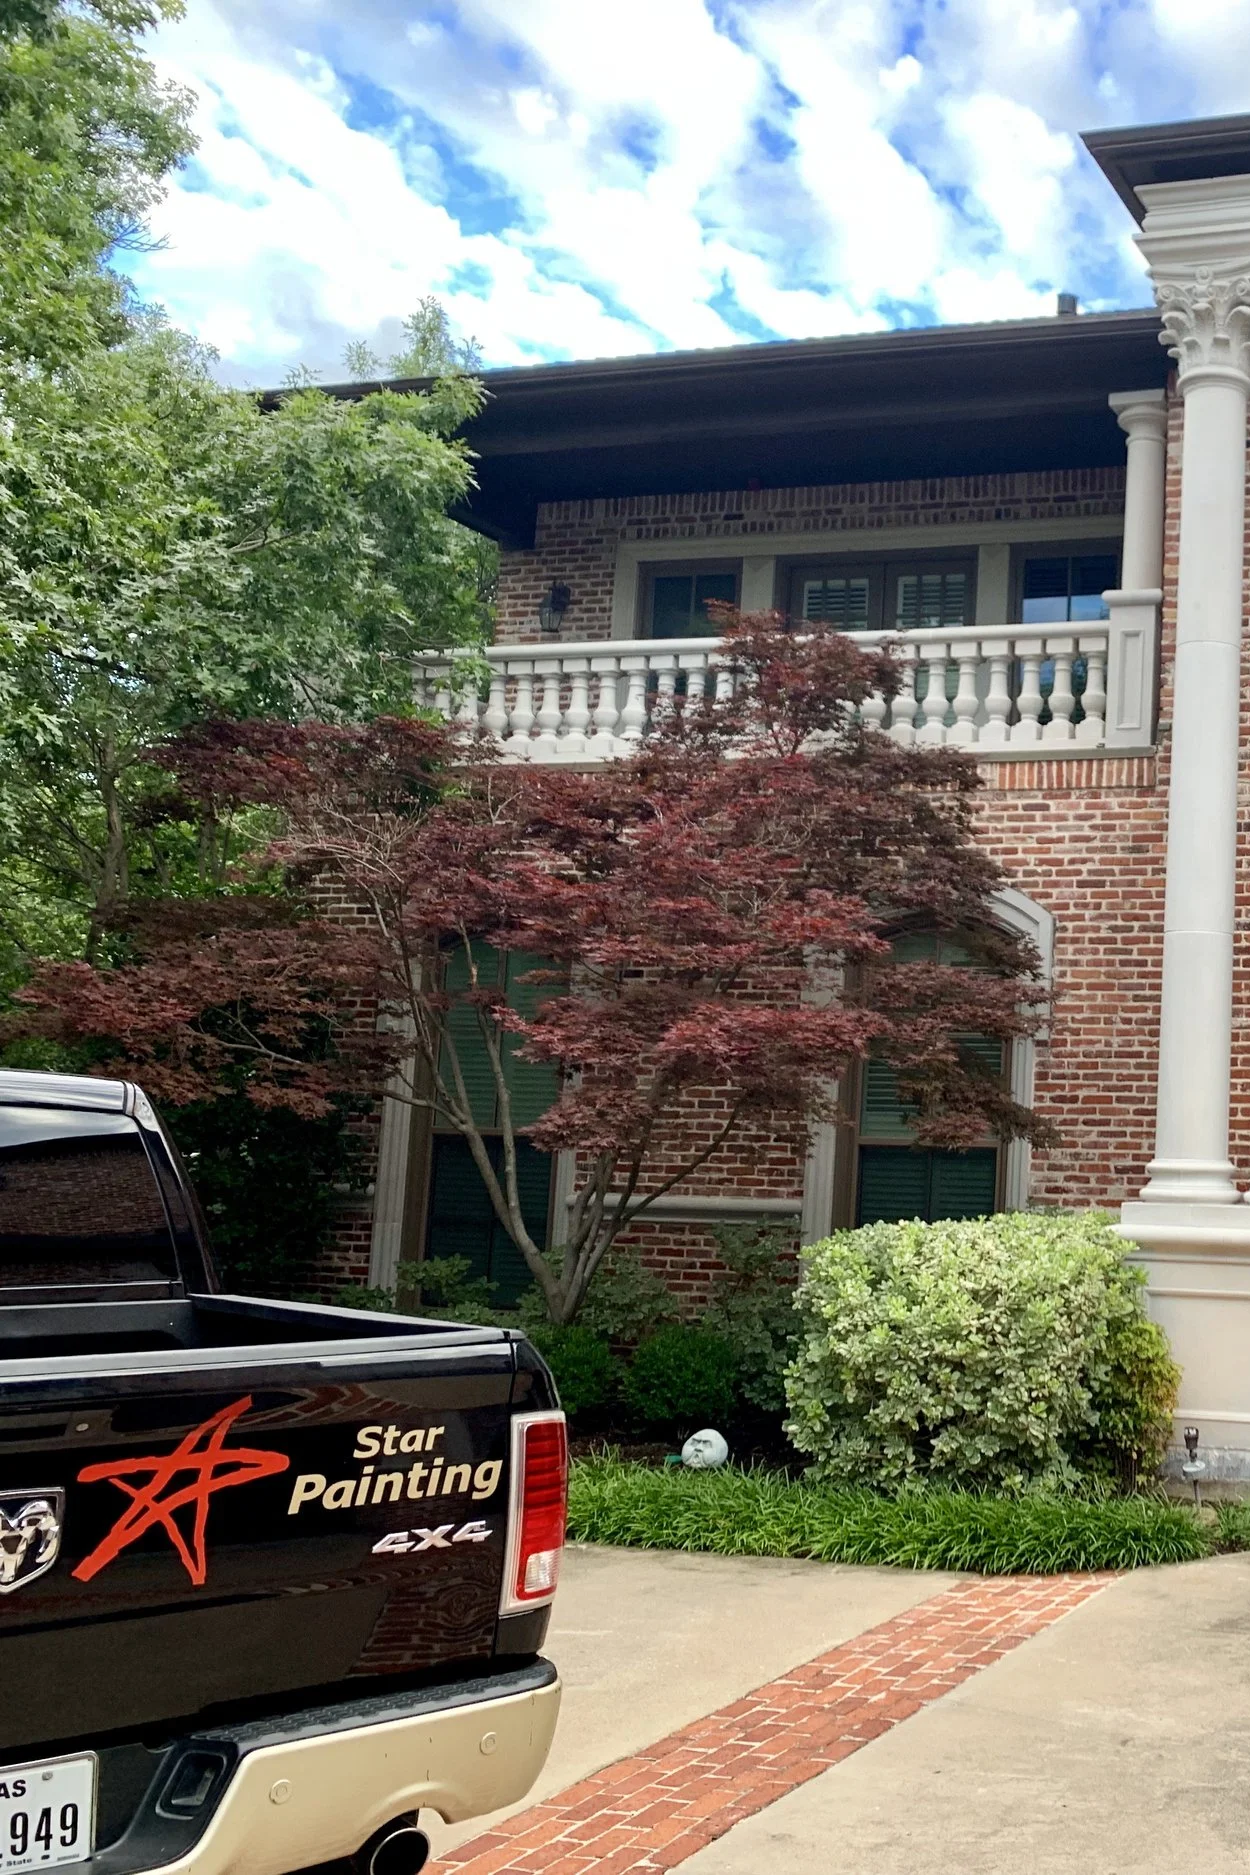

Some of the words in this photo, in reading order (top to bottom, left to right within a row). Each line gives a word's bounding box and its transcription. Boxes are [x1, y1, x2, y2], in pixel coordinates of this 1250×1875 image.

[353, 1425, 445, 1459] Star
[287, 1457, 503, 1515] Painting
[0, 1803, 79, 1858] 949
